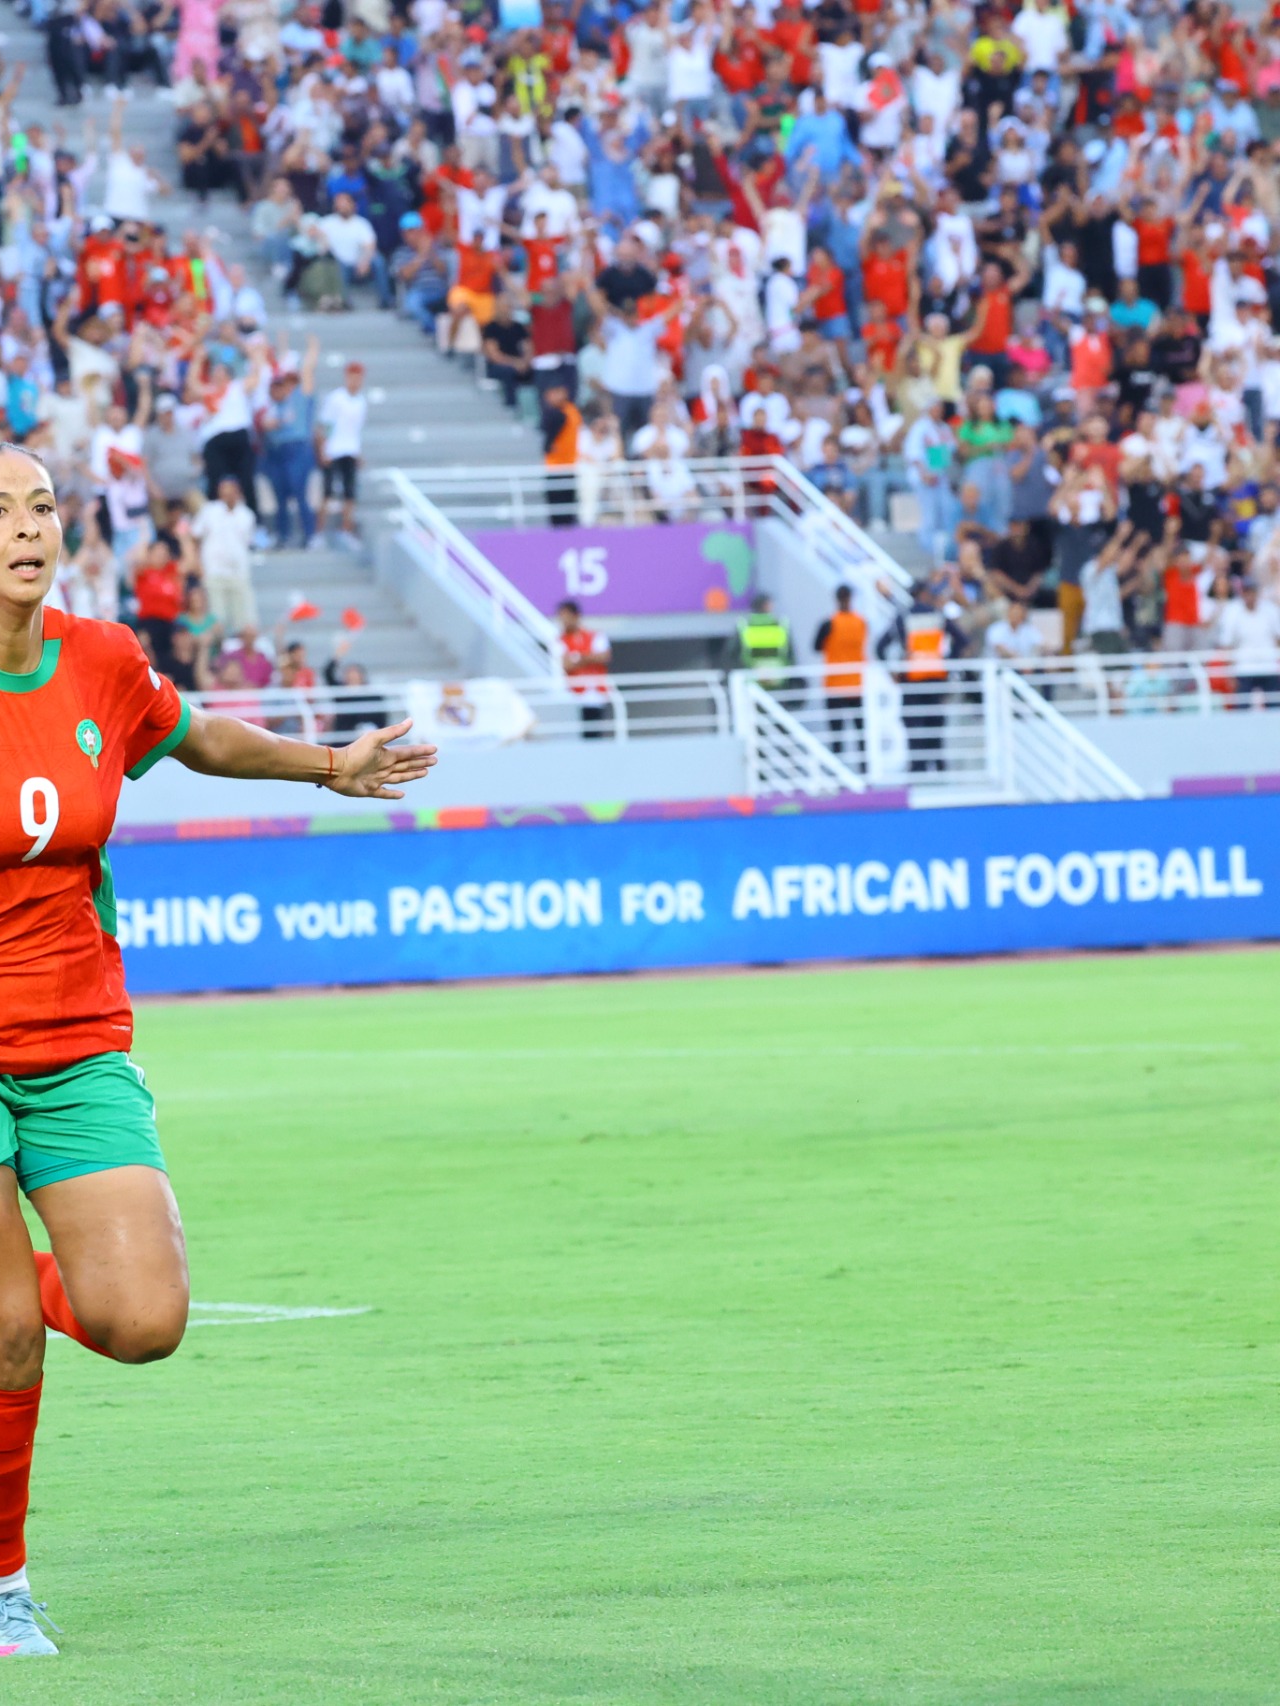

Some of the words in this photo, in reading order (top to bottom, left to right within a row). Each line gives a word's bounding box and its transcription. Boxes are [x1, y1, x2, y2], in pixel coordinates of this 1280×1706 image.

[559, 547, 608, 596] 15
[20, 776, 60, 862] 9
[275, 900, 377, 940] YOUR
[389, 879, 602, 935] PASSION
[621, 881, 704, 924] FOR
[732, 858, 969, 919] AFRICAN
[985, 846, 1263, 907] FOOTBALL
